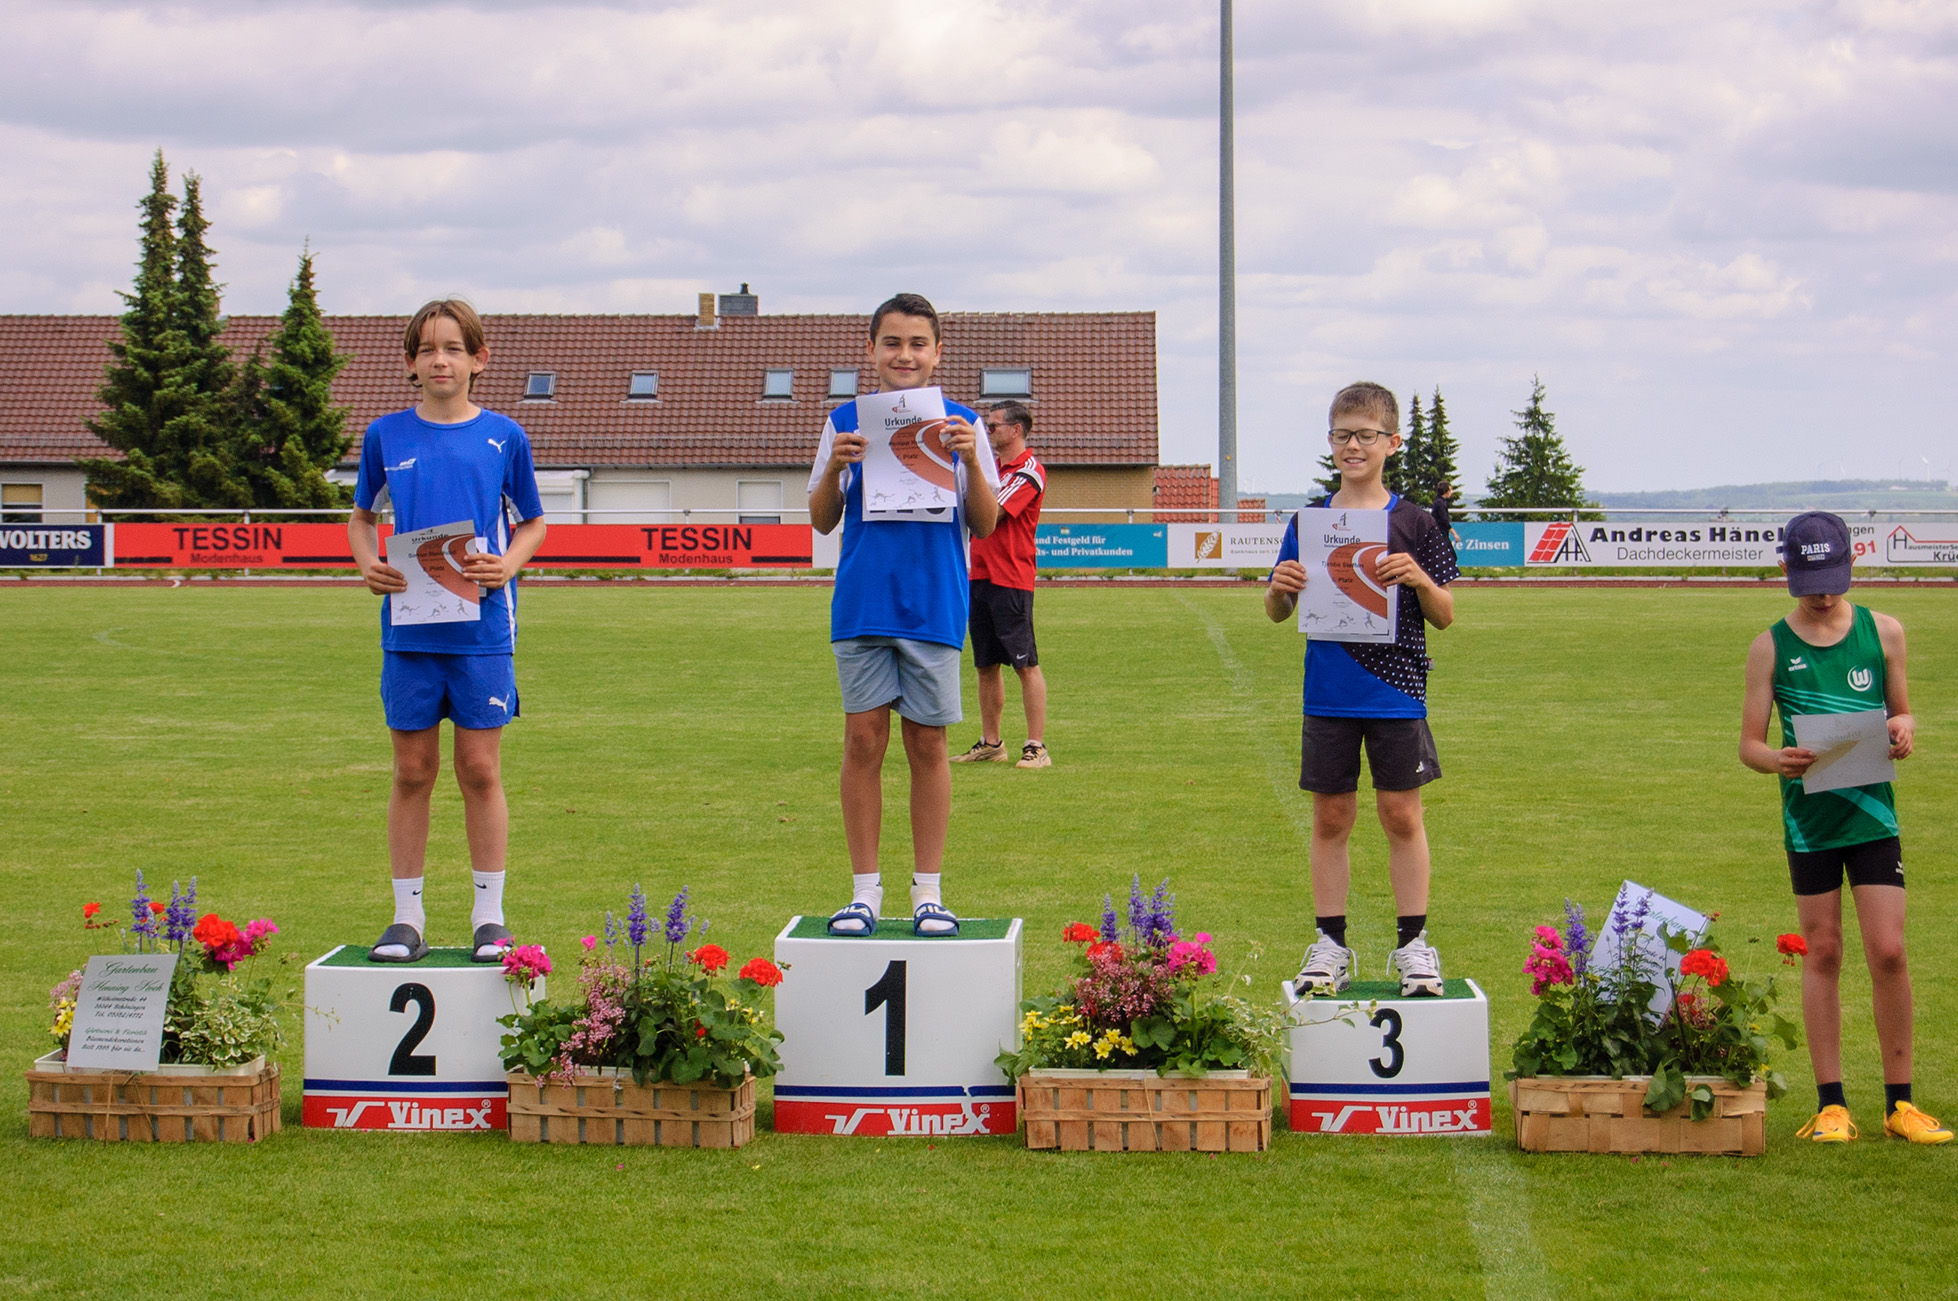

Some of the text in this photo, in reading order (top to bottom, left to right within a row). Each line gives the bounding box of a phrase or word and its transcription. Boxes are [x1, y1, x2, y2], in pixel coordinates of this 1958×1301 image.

[884, 415, 923, 427] Urkunde
[173, 527, 282, 550] TESSIN
[641, 527, 752, 551] TESSIN
[1052, 535, 1090, 546] Festgeld
[1091, 535, 1106, 545] für
[1323, 534, 1361, 544] Urkunde
[1589, 526, 1783, 543] Andreas Hänel
[1051, 547, 1069, 556] und
[1070, 547, 1133, 556] Privatkunden
[1465, 539, 1510, 550] Zinsen
[1800, 542, 1831, 555] PARIS
[190, 553, 263, 564] Modenhaus
[658, 553, 734, 564] Modenhaus
[1617, 546, 1764, 561] Dachdeckermeister
[98, 961, 158, 978] Gartenbau
[865, 959, 907, 1076] 1
[388, 982, 437, 1076] 2
[1368, 1007, 1405, 1079] 3
